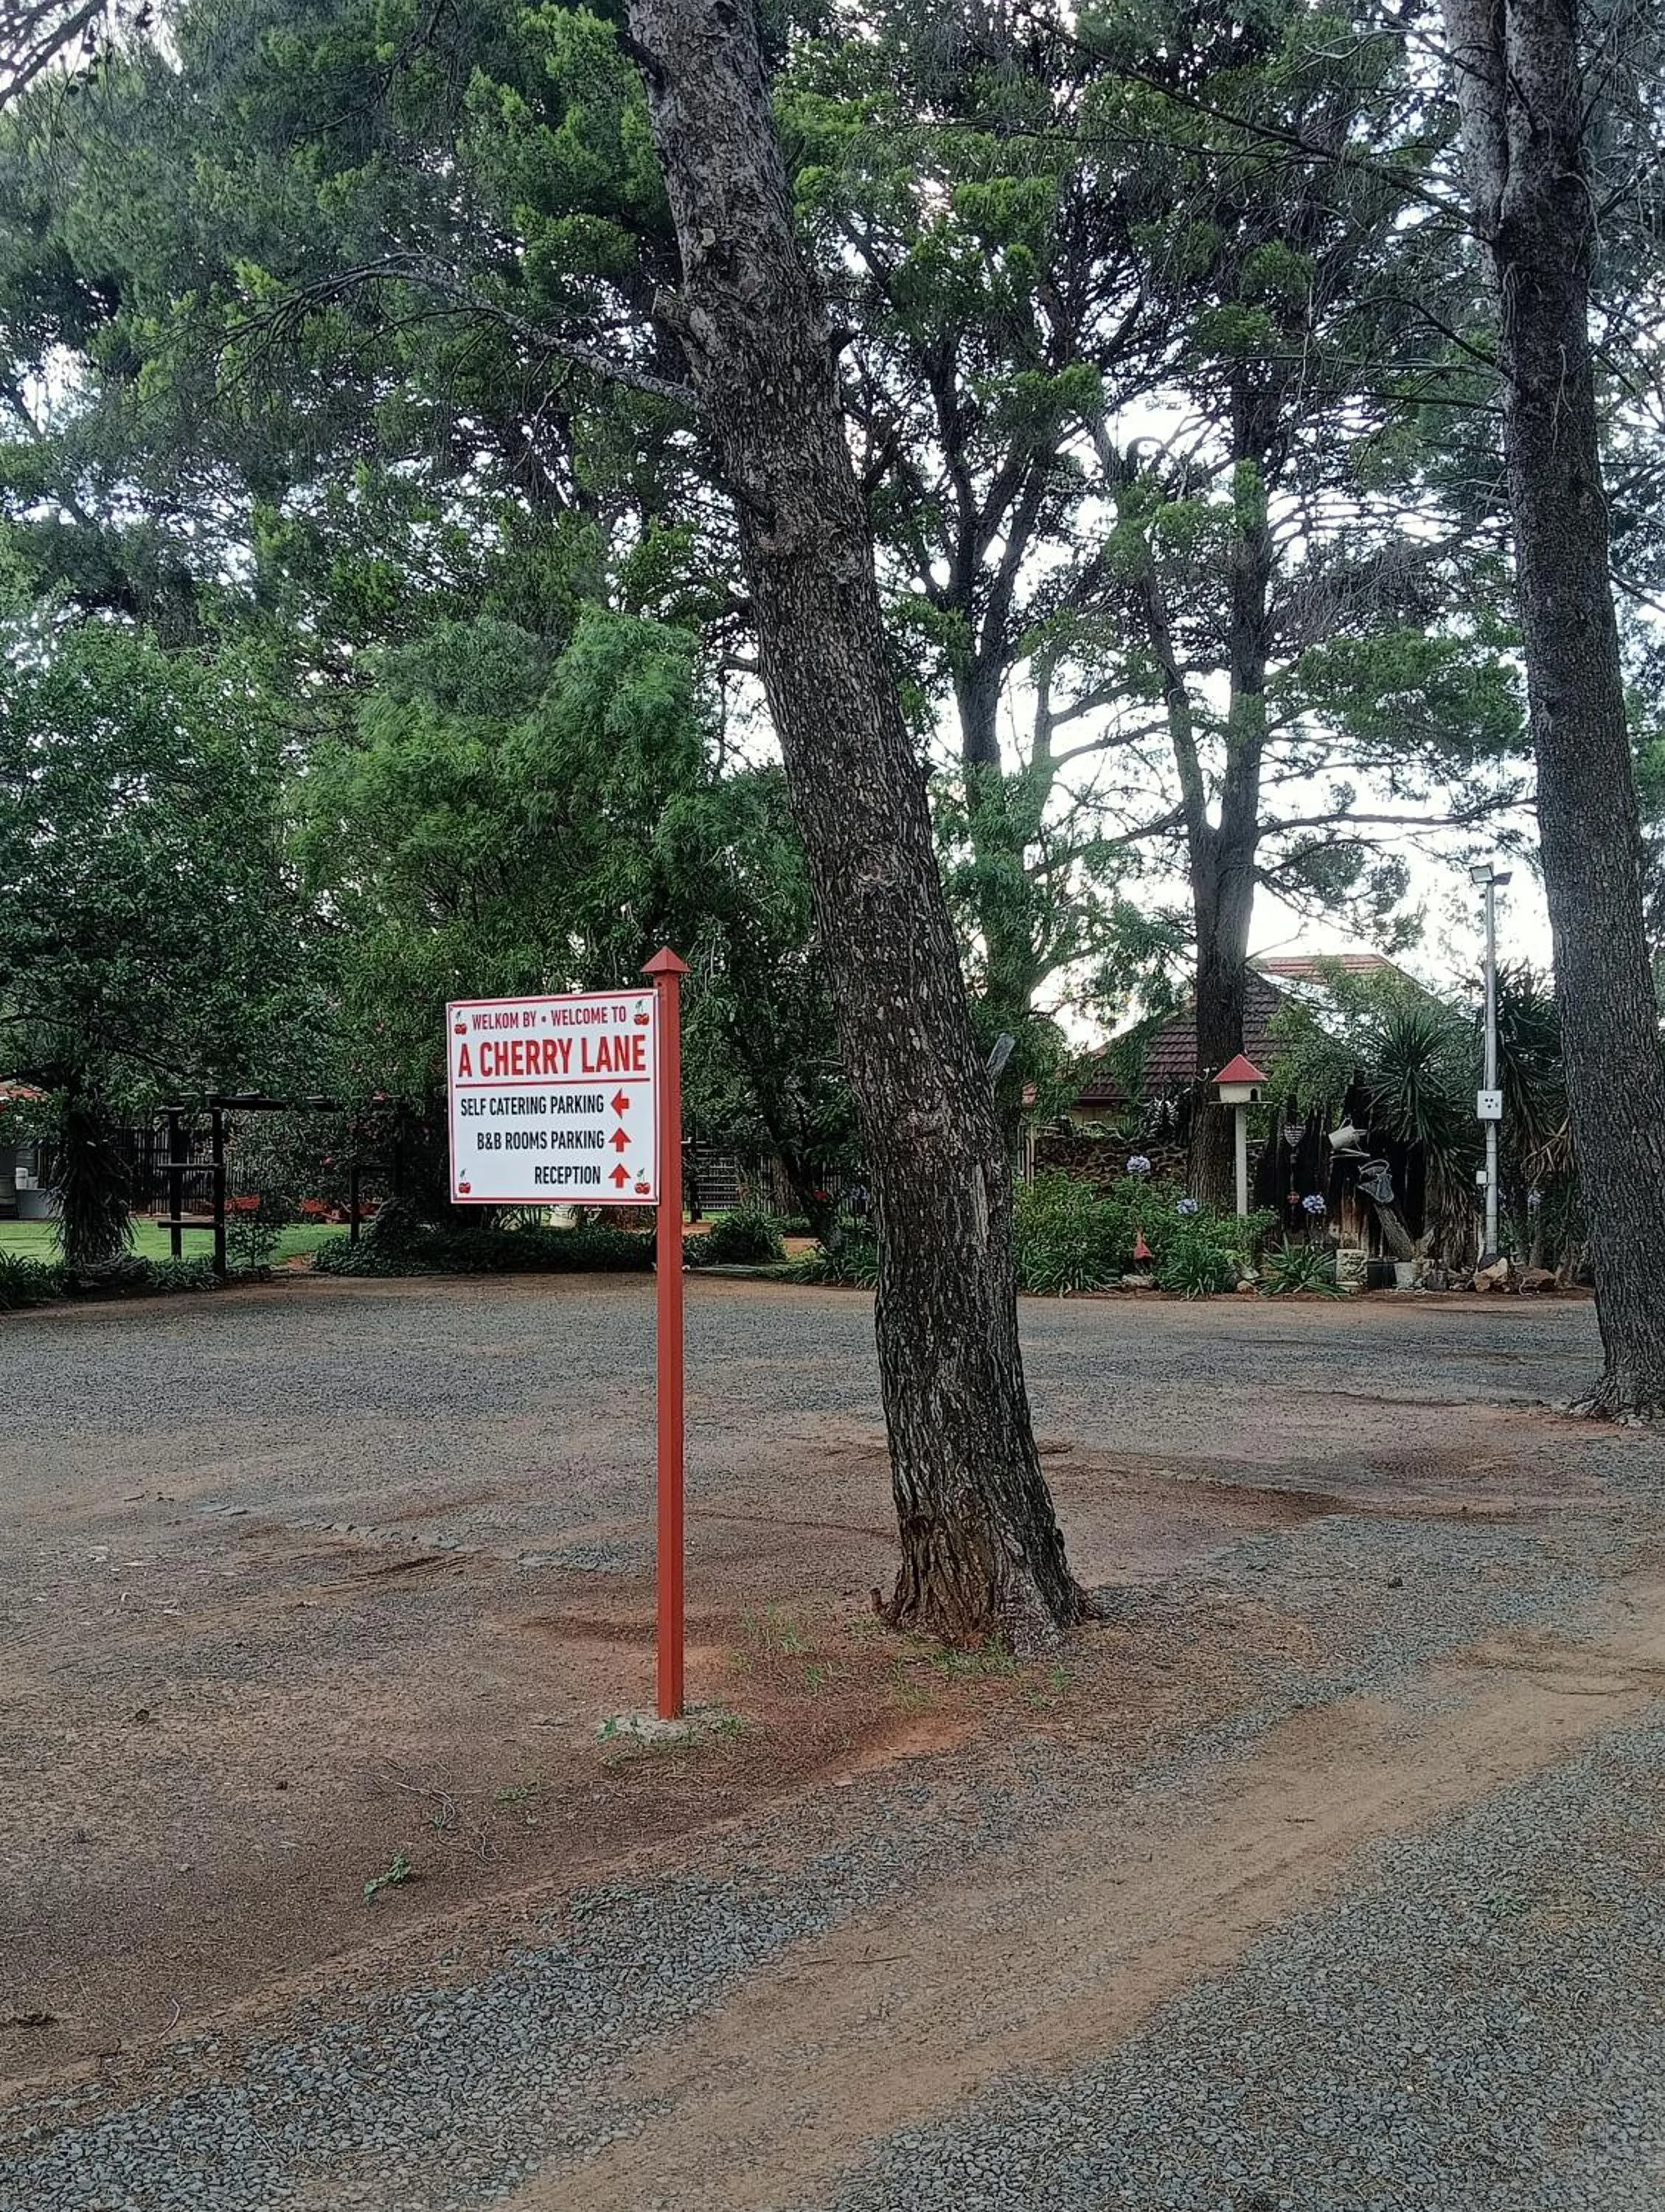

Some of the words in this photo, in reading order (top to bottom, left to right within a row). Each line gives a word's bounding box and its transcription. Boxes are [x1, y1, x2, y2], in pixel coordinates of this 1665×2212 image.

[472, 1012, 518, 1030] WELKOM
[522, 1011, 537, 1027] BY
[551, 1007, 608, 1026] WELCOME
[612, 1006, 626, 1023] TO
[458, 1043, 472, 1077] A
[480, 1038, 573, 1077] CHERRY
[581, 1034, 646, 1073] LANE
[461, 1098, 486, 1116] SELF
[490, 1096, 546, 1115] CATERING
[551, 1094, 604, 1113] PARKING
[477, 1133, 501, 1150] B&B
[506, 1131, 547, 1150] ROOMS
[551, 1130, 604, 1149] PARKING
[535, 1166, 601, 1184] RECEPTION
